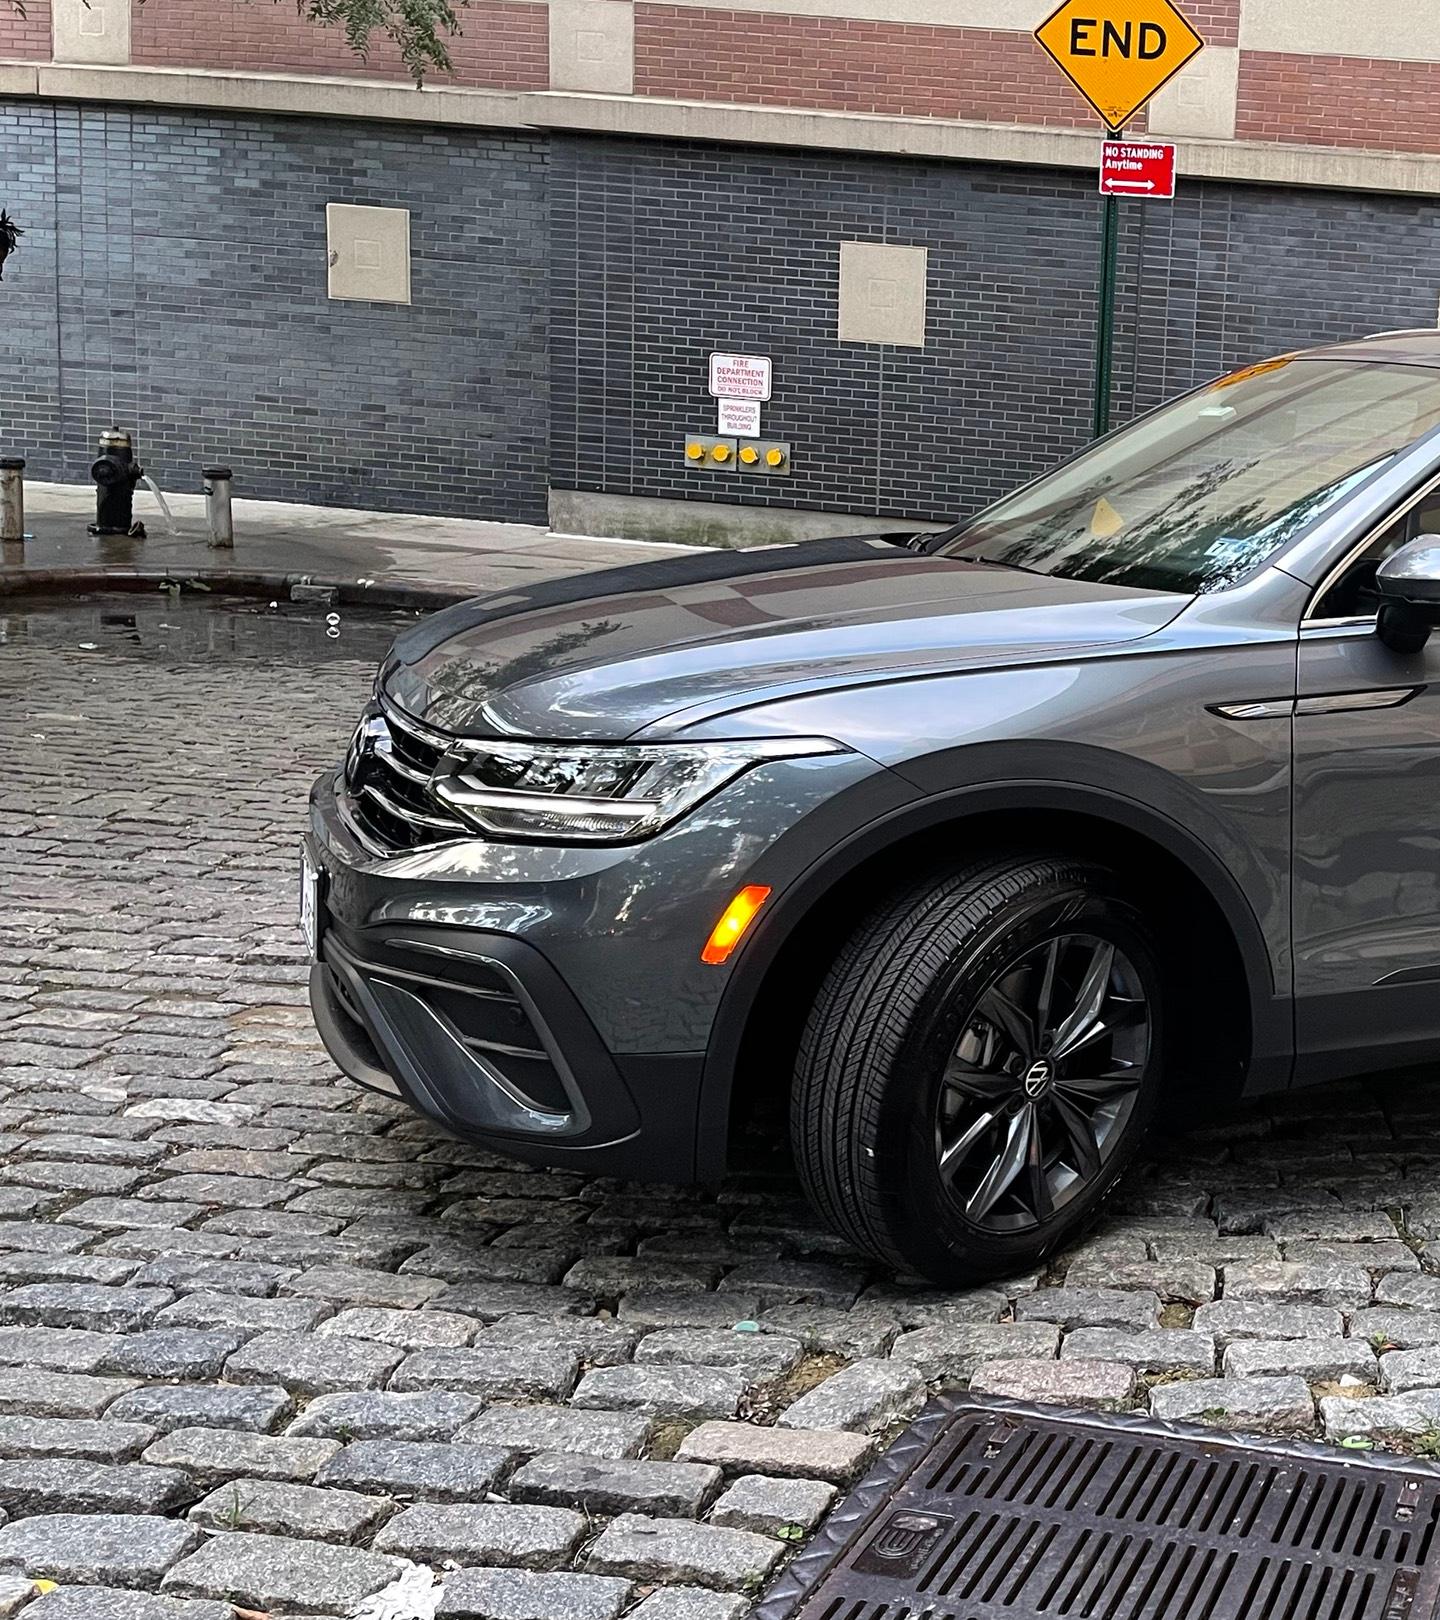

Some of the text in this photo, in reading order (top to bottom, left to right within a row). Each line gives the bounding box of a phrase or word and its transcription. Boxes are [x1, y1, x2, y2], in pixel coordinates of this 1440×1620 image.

[1070, 18, 1167, 60] END
[1105, 146, 1164, 159] NO STANDING
[1105, 158, 1143, 171] Anytime
[733, 360, 749, 368] FIRE
[717, 367, 764, 377] DEPARTMENT
[717, 376, 763, 386] CONNECTION
